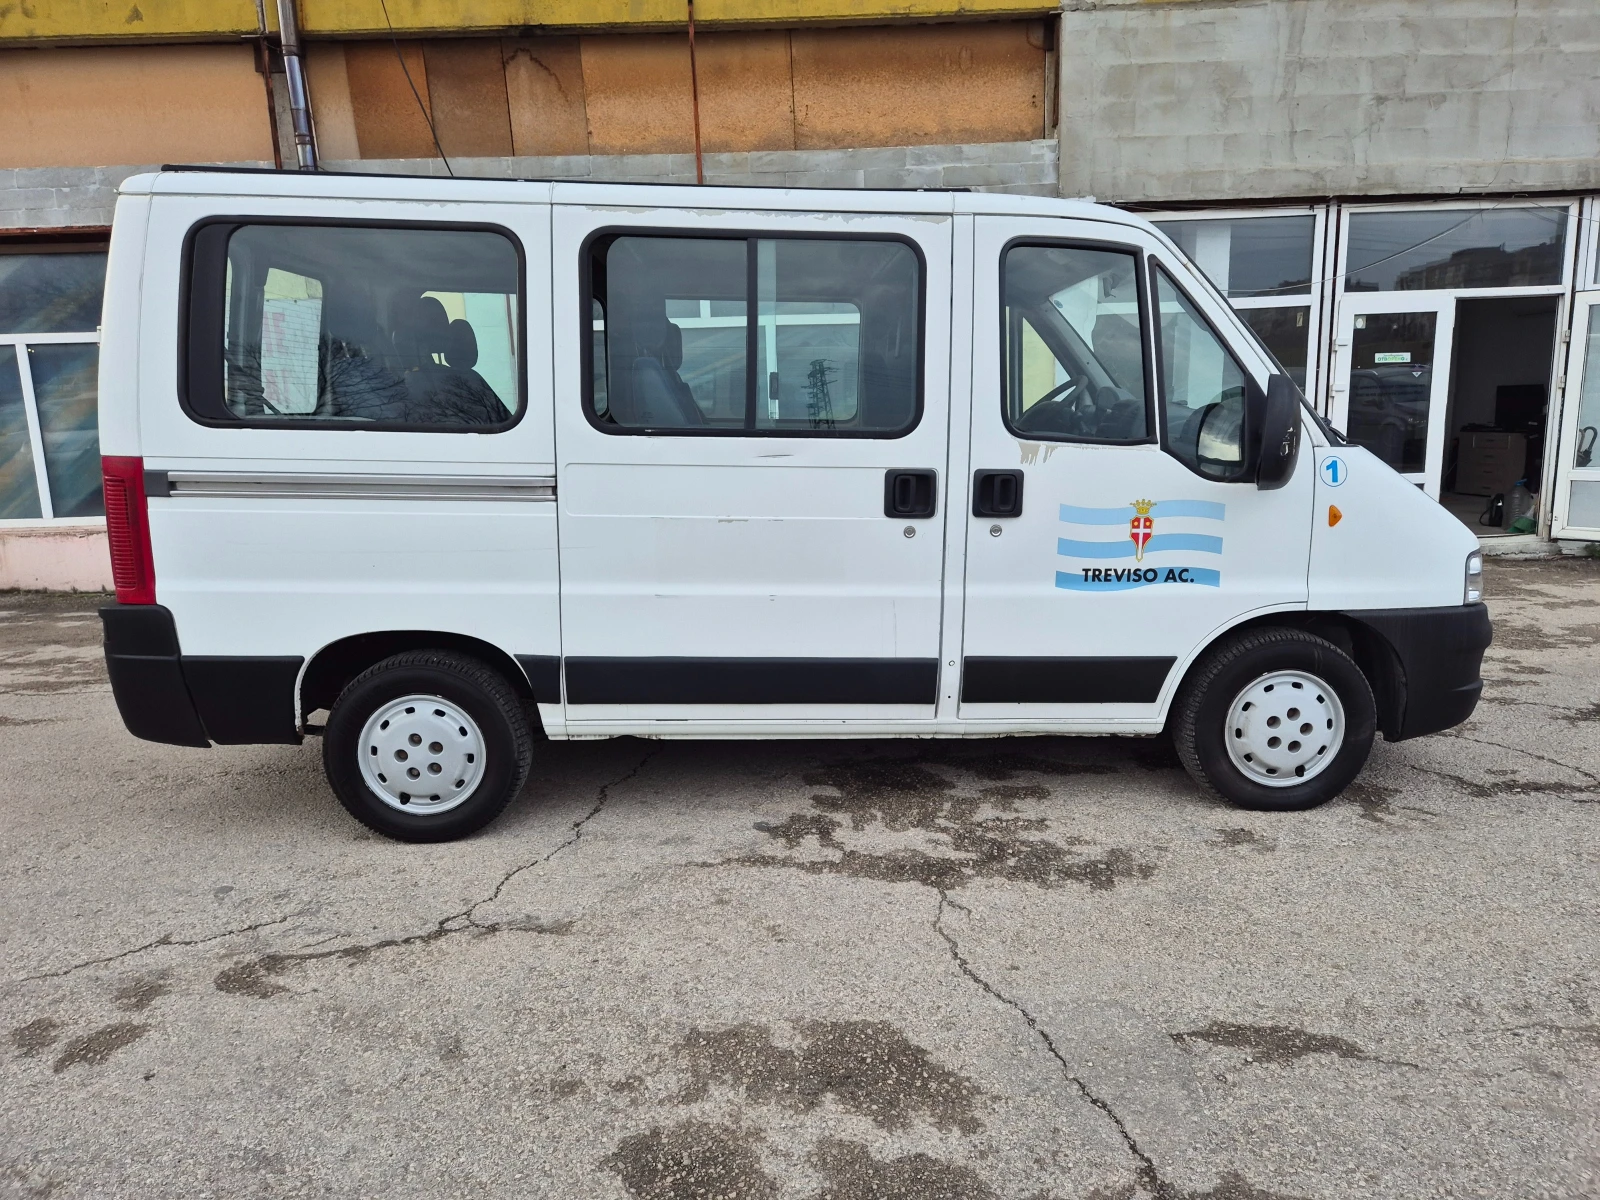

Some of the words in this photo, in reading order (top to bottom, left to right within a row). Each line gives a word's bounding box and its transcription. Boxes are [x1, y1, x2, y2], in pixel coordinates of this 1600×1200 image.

[1326, 460, 1338, 482] 1
[1082, 568, 1158, 582] TREVISO
[1164, 568, 1194, 583] AC.
